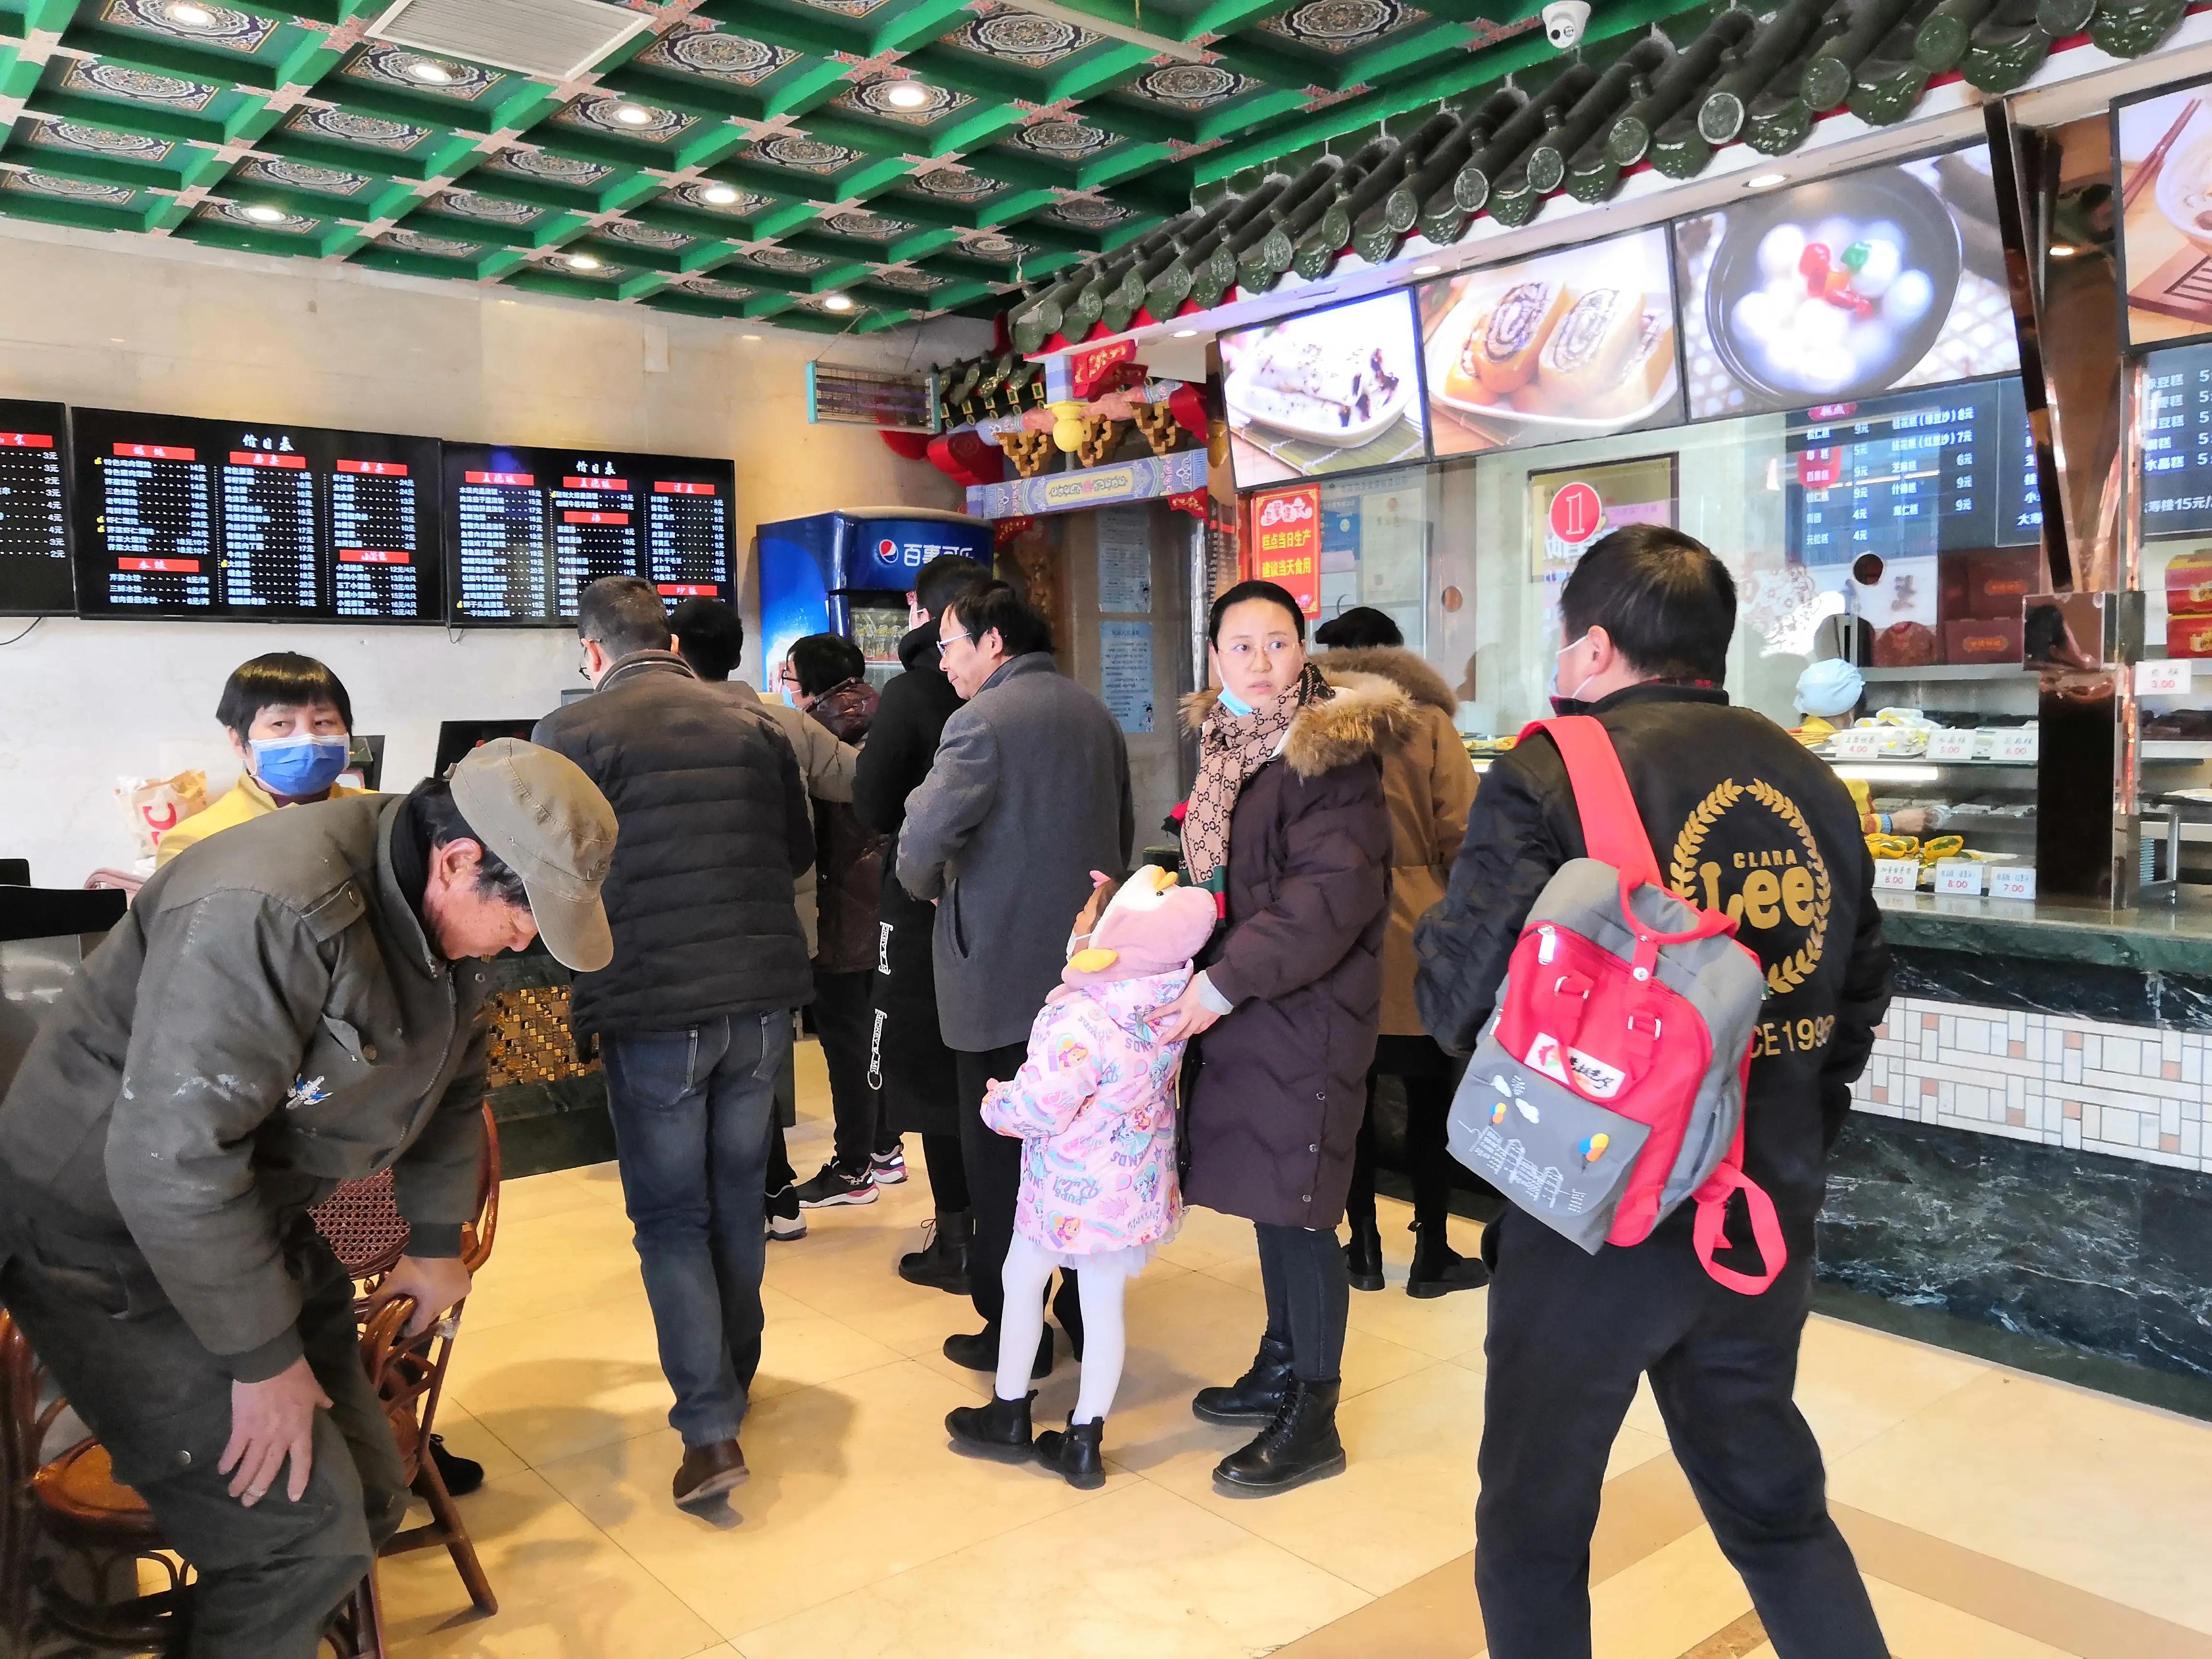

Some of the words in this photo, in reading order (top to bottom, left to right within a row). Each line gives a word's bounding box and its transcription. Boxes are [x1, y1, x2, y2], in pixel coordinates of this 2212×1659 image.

[2199, 369, 2212, 383] 5
[2199, 390, 2212, 403] 5
[2198, 410, 2212, 423] 5
[1854, 421, 1870, 434] 9元
[2197, 432, 2212, 445] 5
[1854, 442, 1868, 456] 5元
[1957, 453, 1973, 466] 6元
[2145, 456, 2185, 471] 水晶糕
[2196, 452, 2212, 465] 5
[1854, 465, 1869, 478] 9元
[1956, 475, 1973, 489] 9元
[1853, 486, 1868, 499] 9元
[1955, 498, 1972, 511] 9元
[1566, 491, 1585, 535] 1
[1852, 507, 1867, 520] 4元
[1852, 529, 1867, 541] 4元
[1262, 557, 1311, 578] 建议当天食用
[1947, 879, 1968, 889] 8.00
[1700, 862, 1814, 932] Lee
